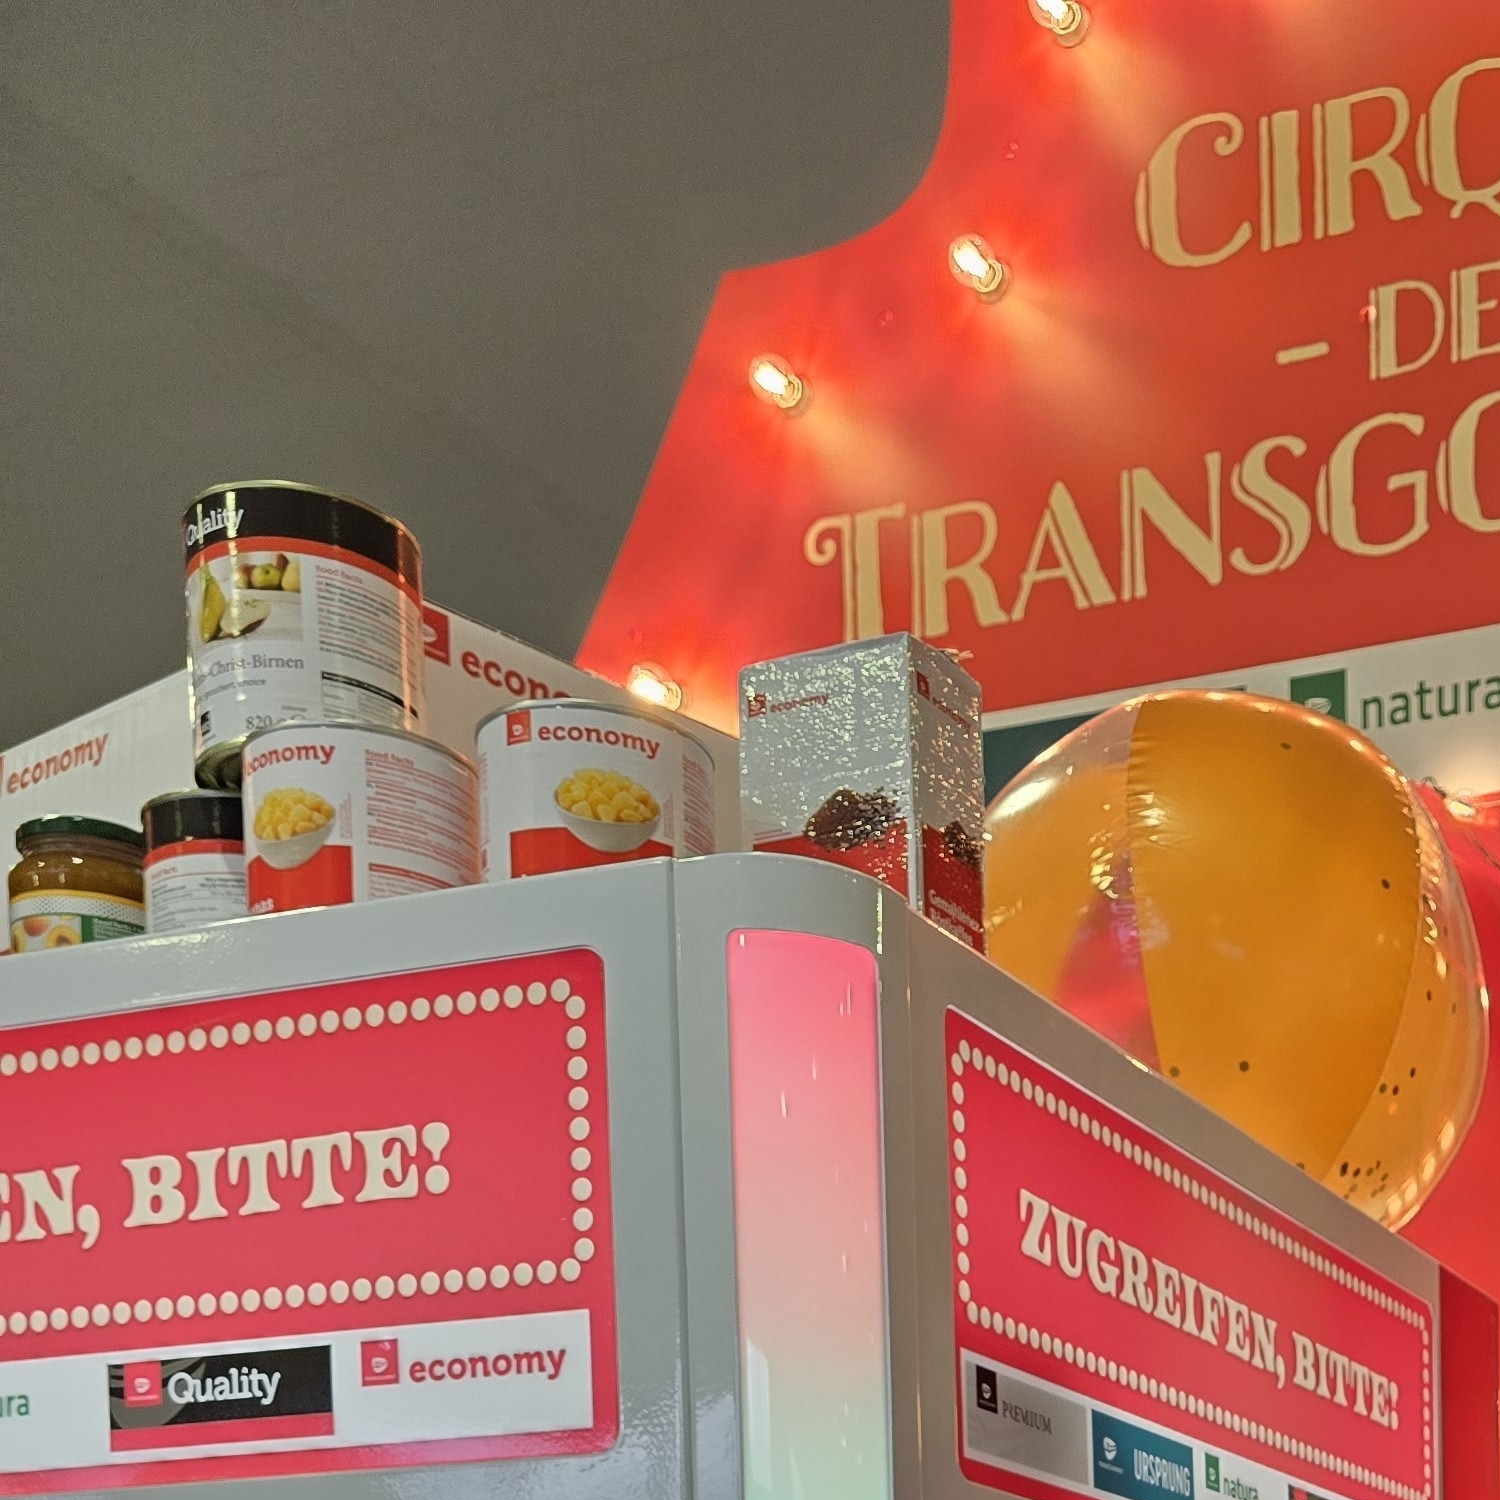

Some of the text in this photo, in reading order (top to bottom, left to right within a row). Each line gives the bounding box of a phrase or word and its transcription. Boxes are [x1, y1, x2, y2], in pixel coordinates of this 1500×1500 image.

[6, 732, 109, 795] economy
[537, 725, 661, 760] economy
[122, 1121, 451, 1228] BITTE!
[0, 1164, 101, 1250] N,
[1018, 1187, 1400, 1431] ZUGREIFEN, BITTE!
[167, 1365, 282, 1407] Quality
[408, 1345, 567, 1384] economy
[1001, 1400, 1053, 1435] PREMIUM
[1133, 1448, 1191, 1497] URSPRUNG
